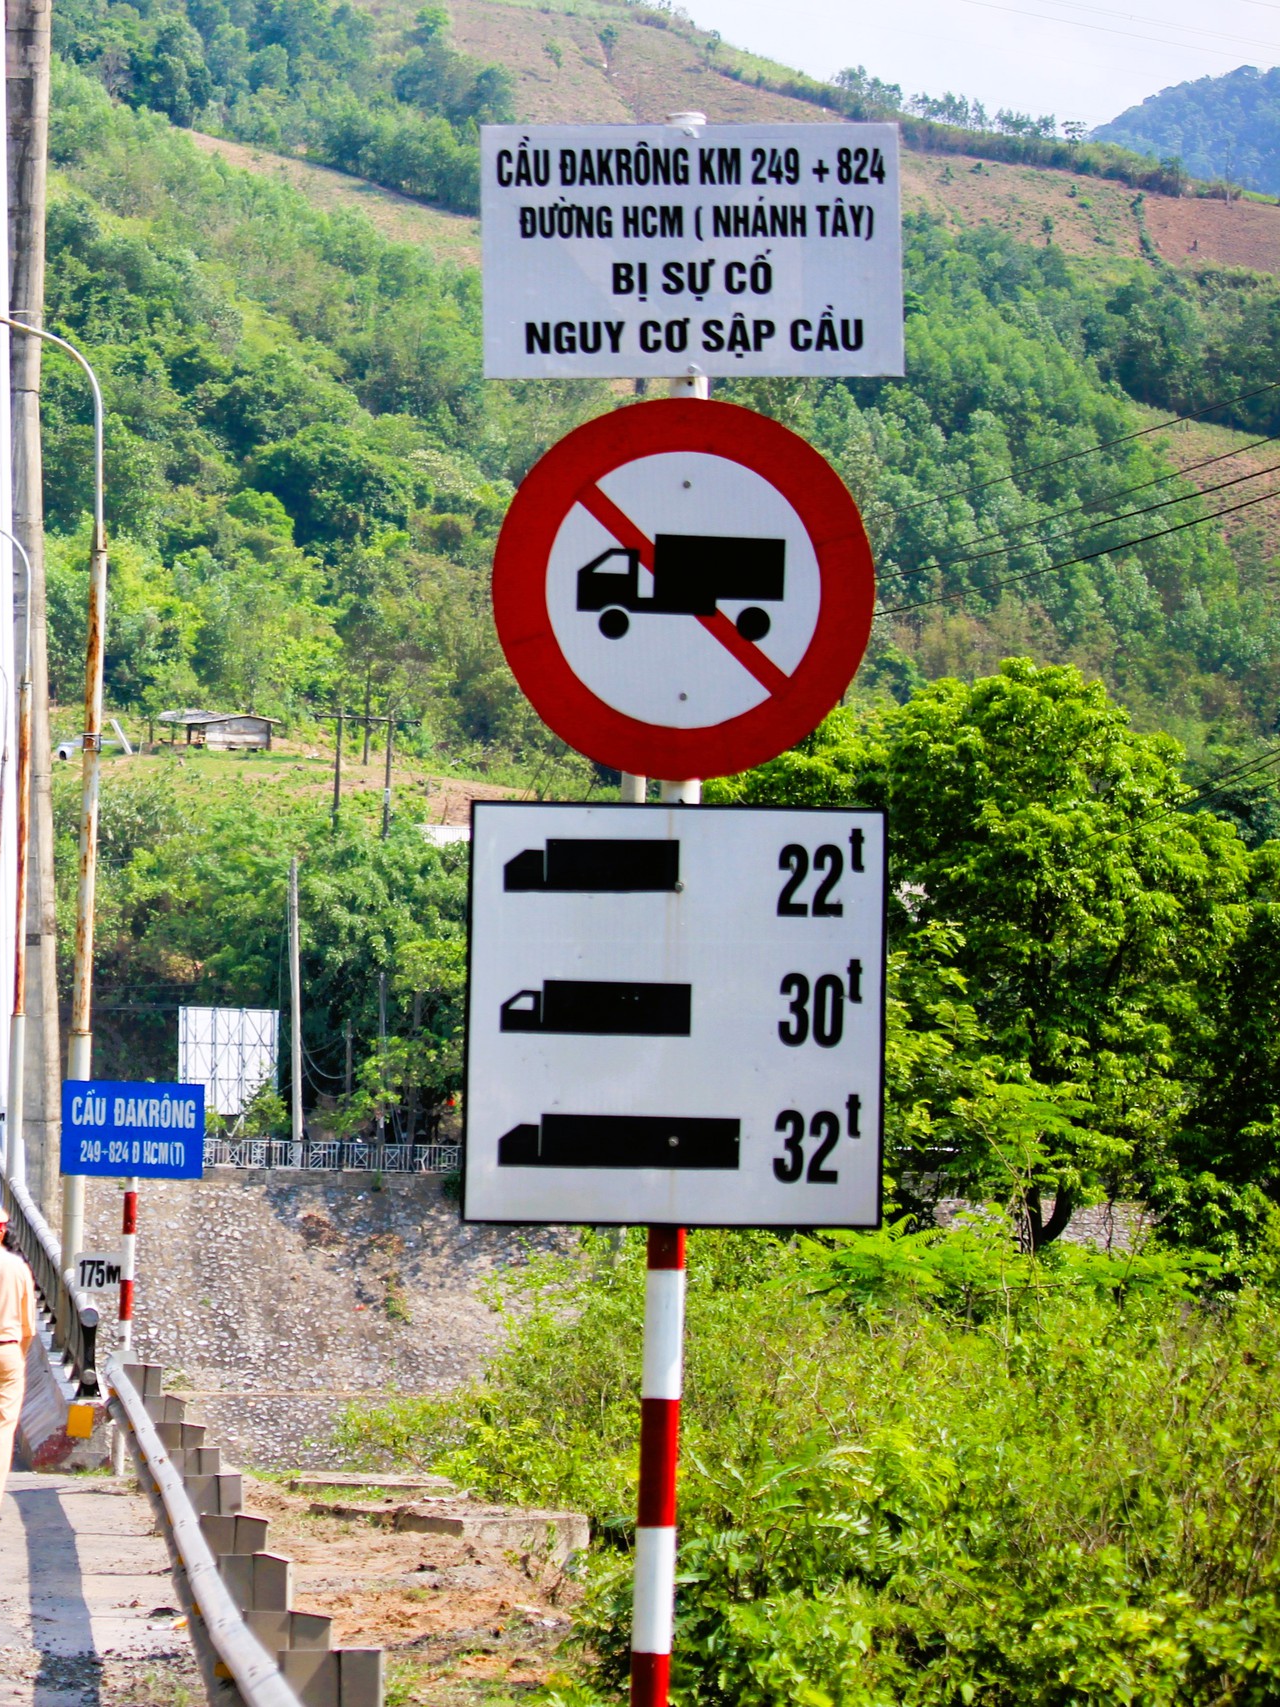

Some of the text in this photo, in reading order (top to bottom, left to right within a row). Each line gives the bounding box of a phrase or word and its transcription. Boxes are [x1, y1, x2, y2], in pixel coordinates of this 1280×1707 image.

[497, 136, 550, 187] CẦU
[559, 141, 689, 186] ĐAKRÔNG
[699, 147, 741, 185] KM
[751, 147, 799, 185] 249
[837, 147, 885, 185] 824
[520, 196, 612, 239] ĐƯỜNG
[622, 205, 684, 238] HCM
[816, 197, 874, 241] TÂY)
[612, 249, 773, 302] BỊ SỰ CỐ
[526, 304, 864, 358] NGUY CƠ SẬP CẦU
[71, 1089, 196, 1129] CẦU ĐAKRÔNG
